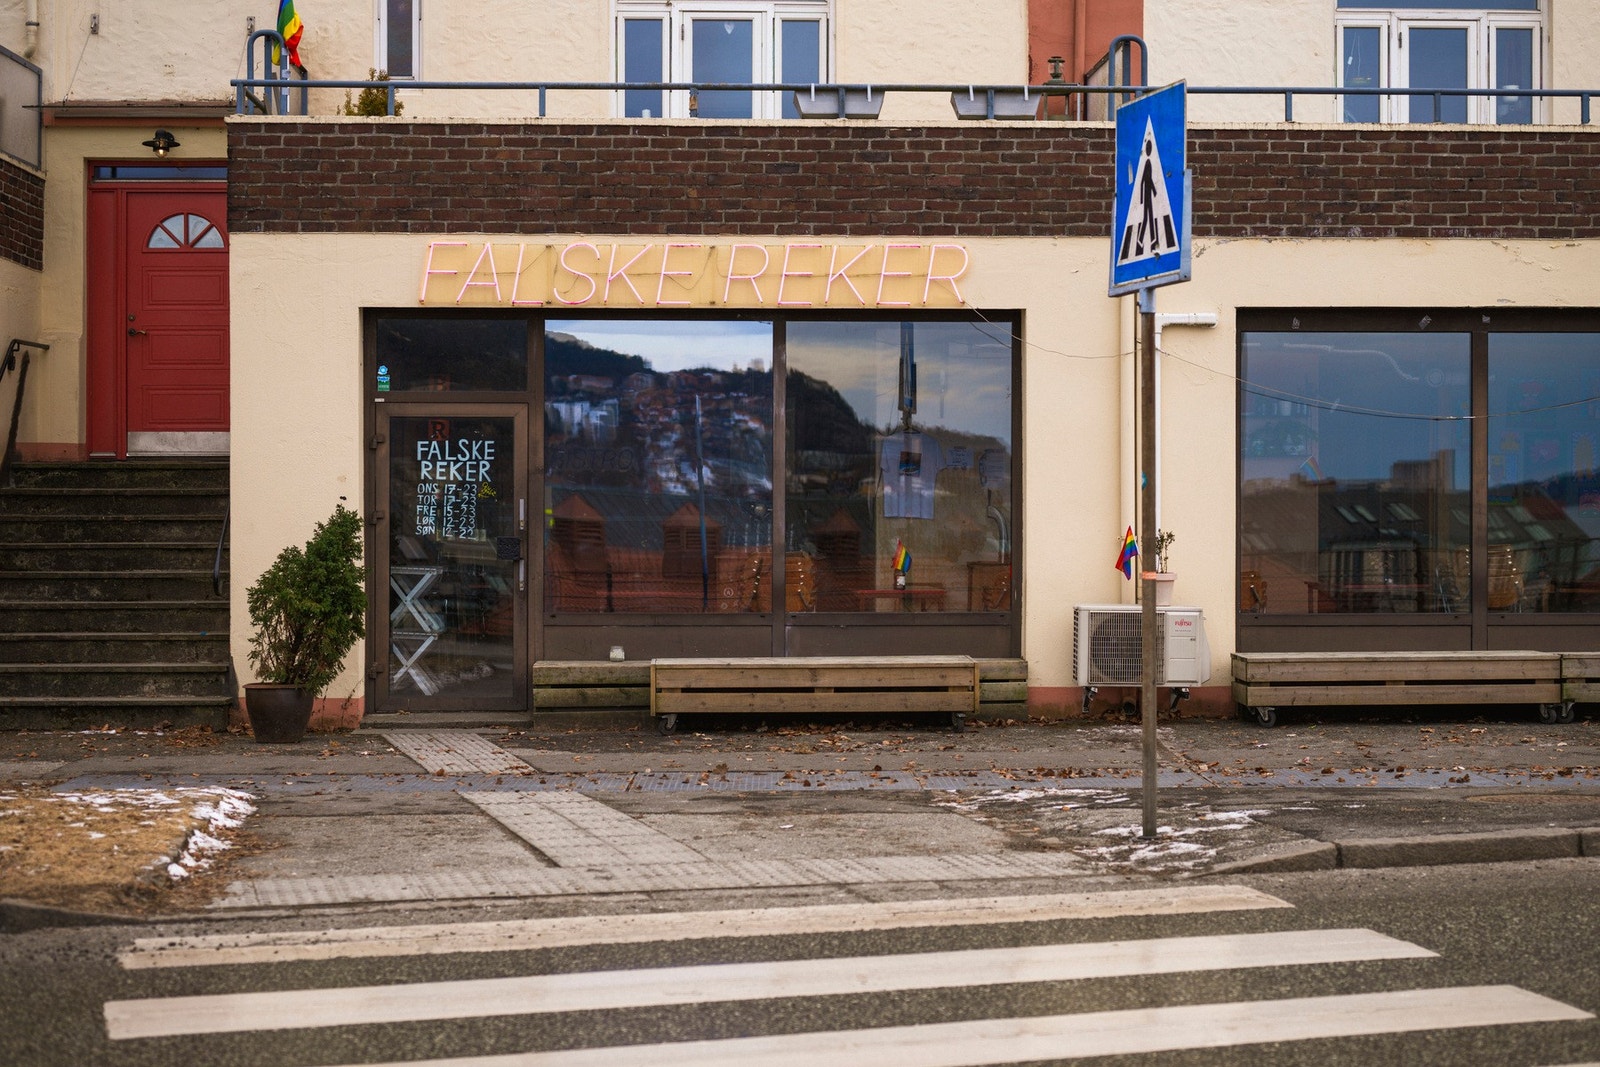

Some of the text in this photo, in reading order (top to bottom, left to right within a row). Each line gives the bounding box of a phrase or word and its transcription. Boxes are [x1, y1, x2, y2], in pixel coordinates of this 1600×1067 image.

[419, 243, 968, 306] FALSKE REKER
[417, 439, 495, 462] FALSKE
[420, 460, 492, 482] REKER
[417, 483, 438, 494] ONS
[417, 495, 437, 505] TOR
[416, 505, 437, 516] FRE
[416, 516, 435, 525] LØR
[415, 526, 436, 535] SØN
